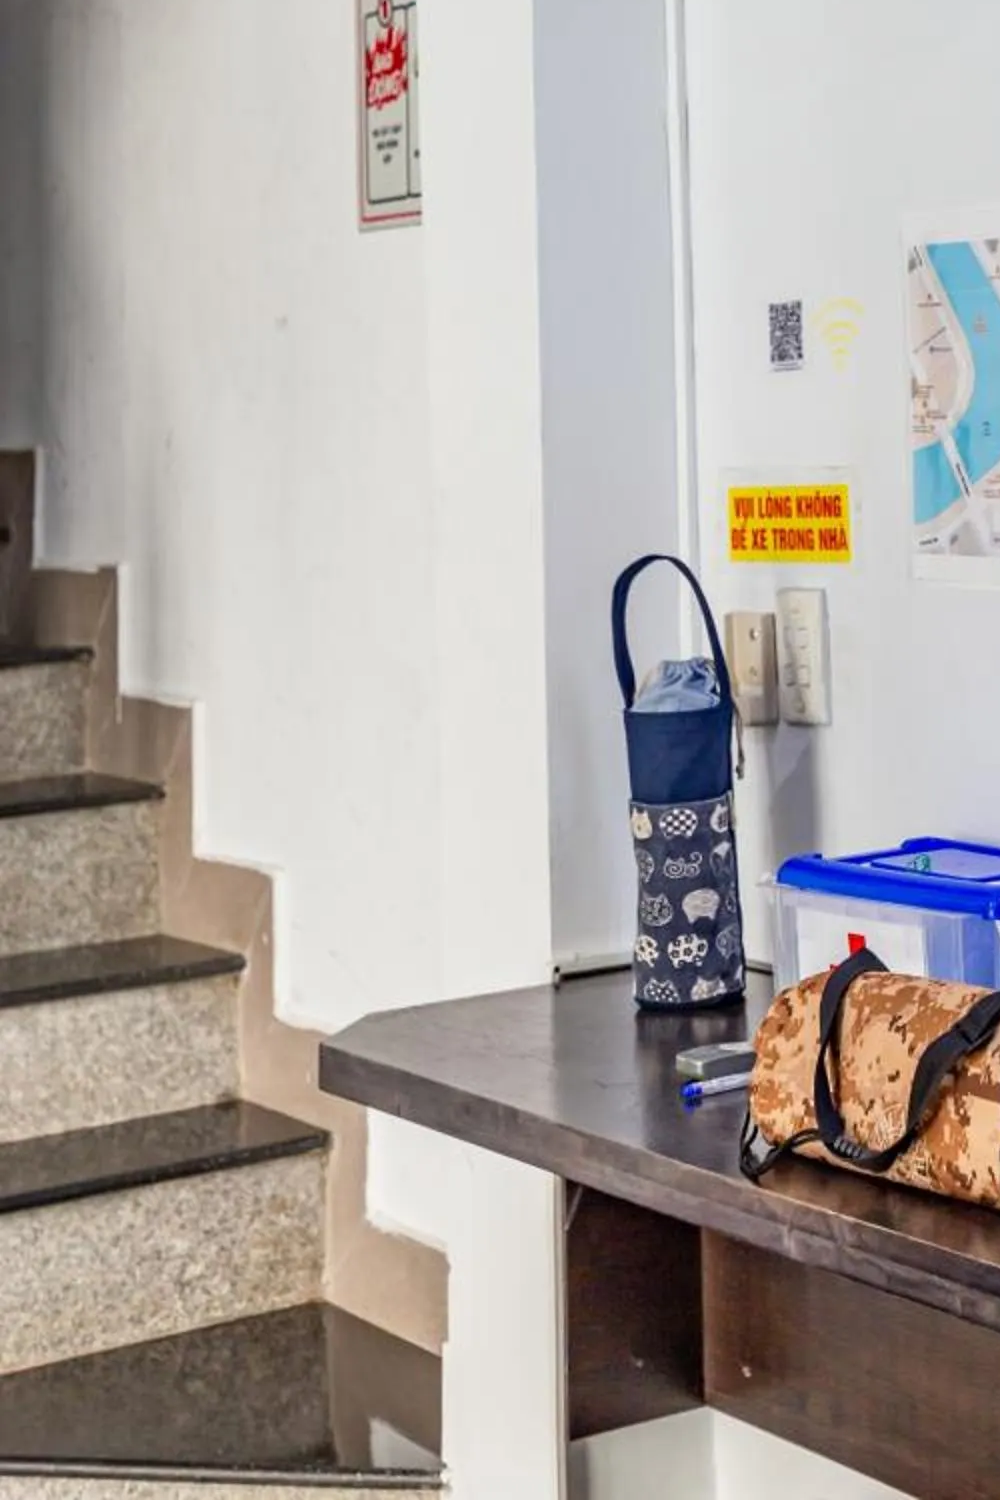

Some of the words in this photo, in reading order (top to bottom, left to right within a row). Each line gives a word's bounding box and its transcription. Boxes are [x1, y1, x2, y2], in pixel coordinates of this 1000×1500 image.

[733, 497, 755, 518] VUI
[758, 491, 792, 518] LÒNG
[795, 490, 842, 518] KHÔNG
[752, 527, 768, 551] XE
[772, 527, 815, 551] TRONG
[819, 523, 850, 551] NHÀ
